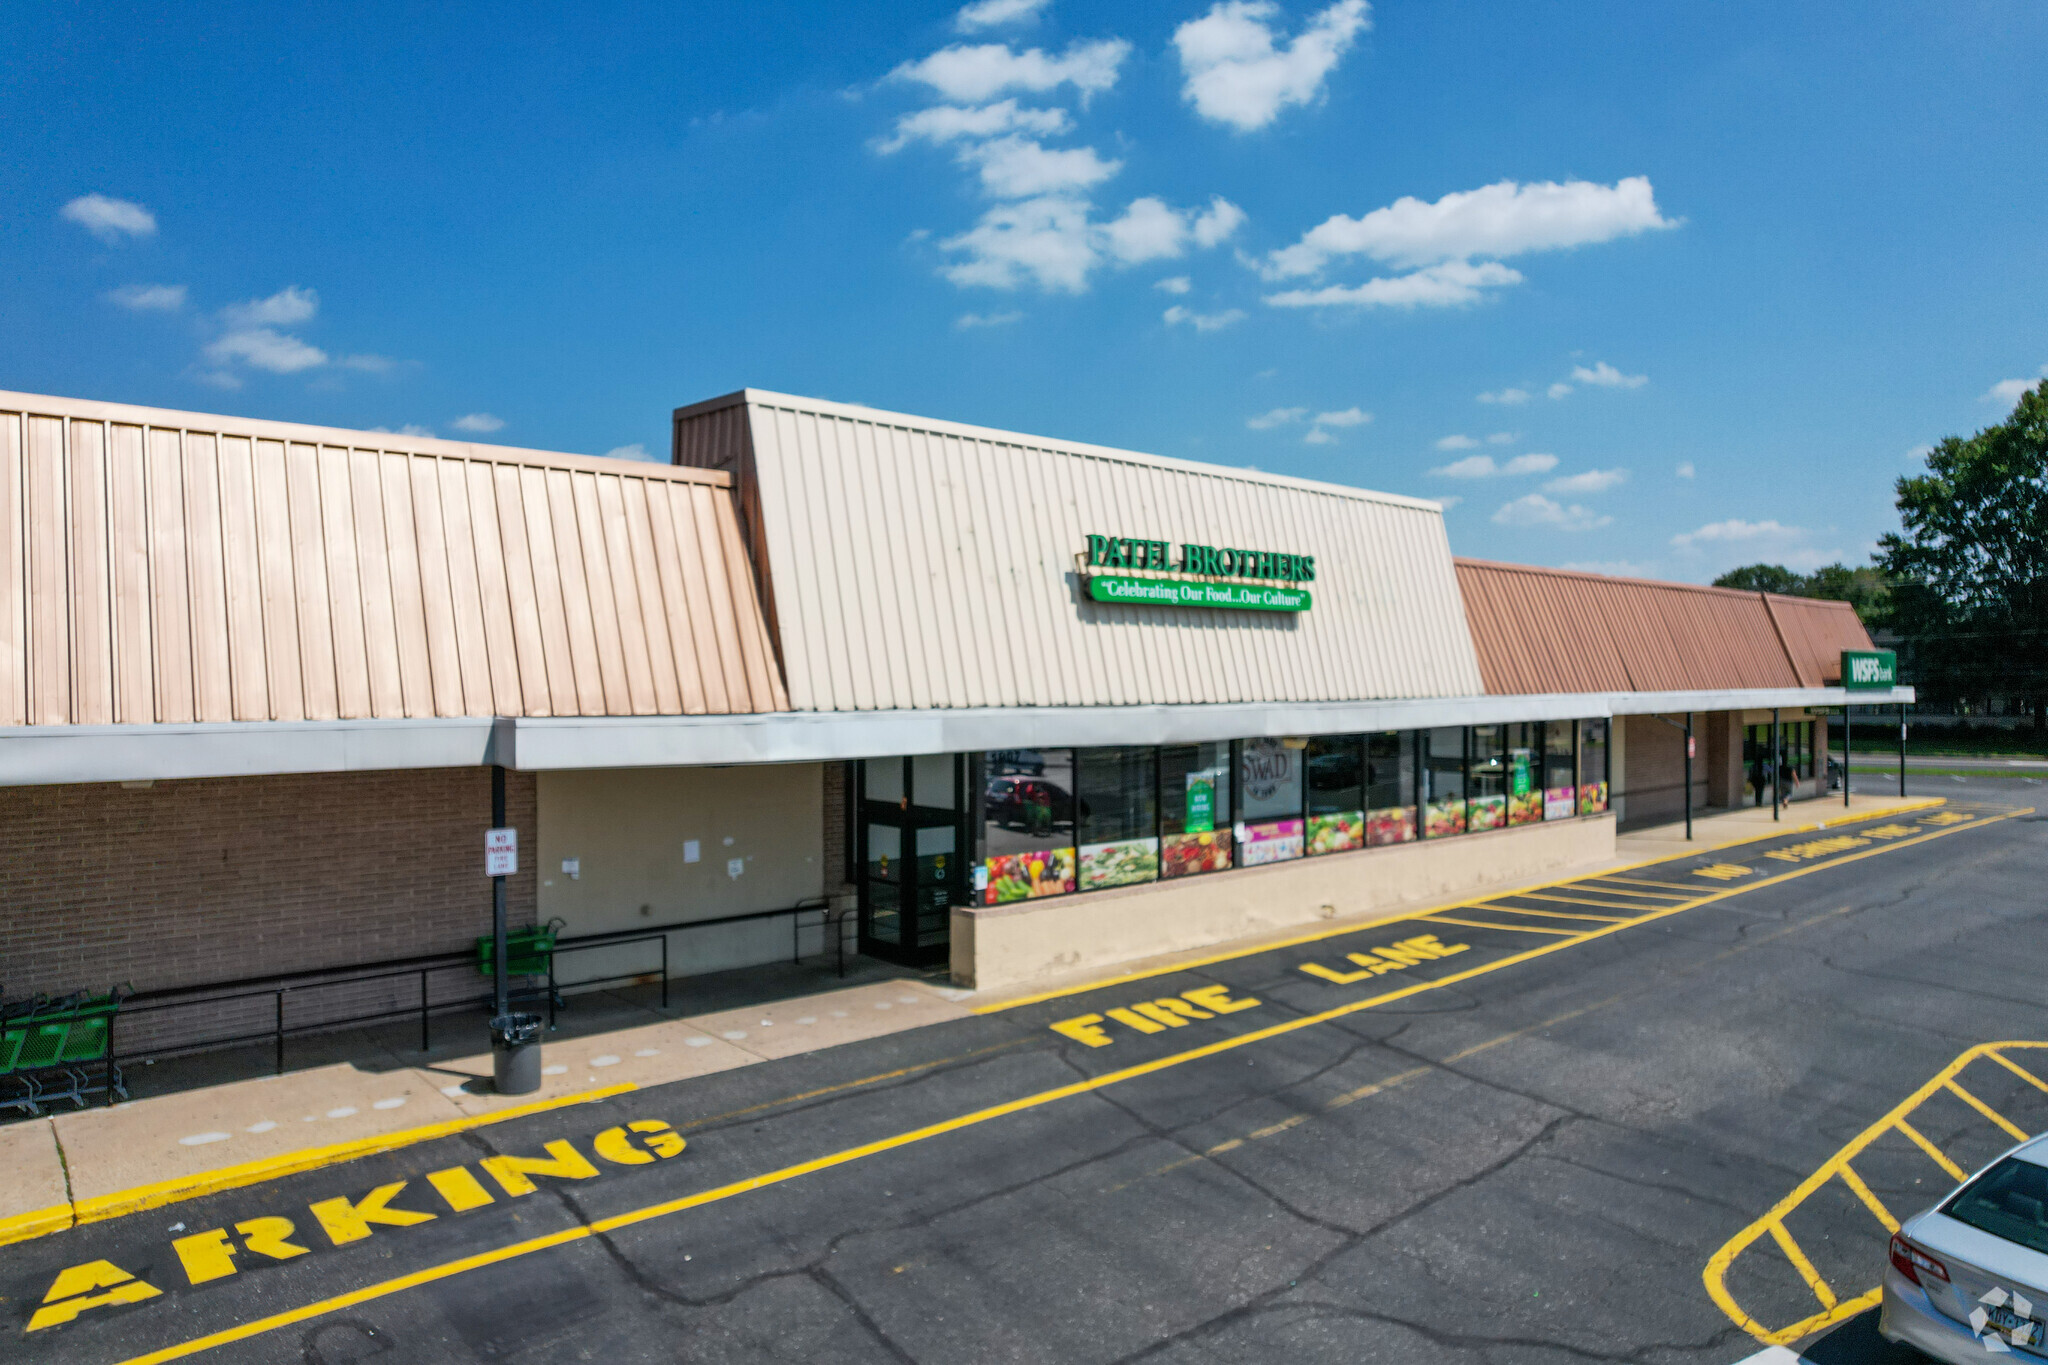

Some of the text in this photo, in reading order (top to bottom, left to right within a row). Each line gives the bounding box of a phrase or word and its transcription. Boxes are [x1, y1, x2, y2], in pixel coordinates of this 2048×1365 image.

[1086, 534, 1316, 581] PATEL BROTHERS
[1180, 585, 1203, 601] Our
[1851, 657, 1893, 683] WSFS bank
[487, 845, 514, 854] PARKING
[495, 835, 507, 843] NO
[1049, 933, 1471, 1048] FIRE LANE
[26, 1118, 688, 1333] ARKING
